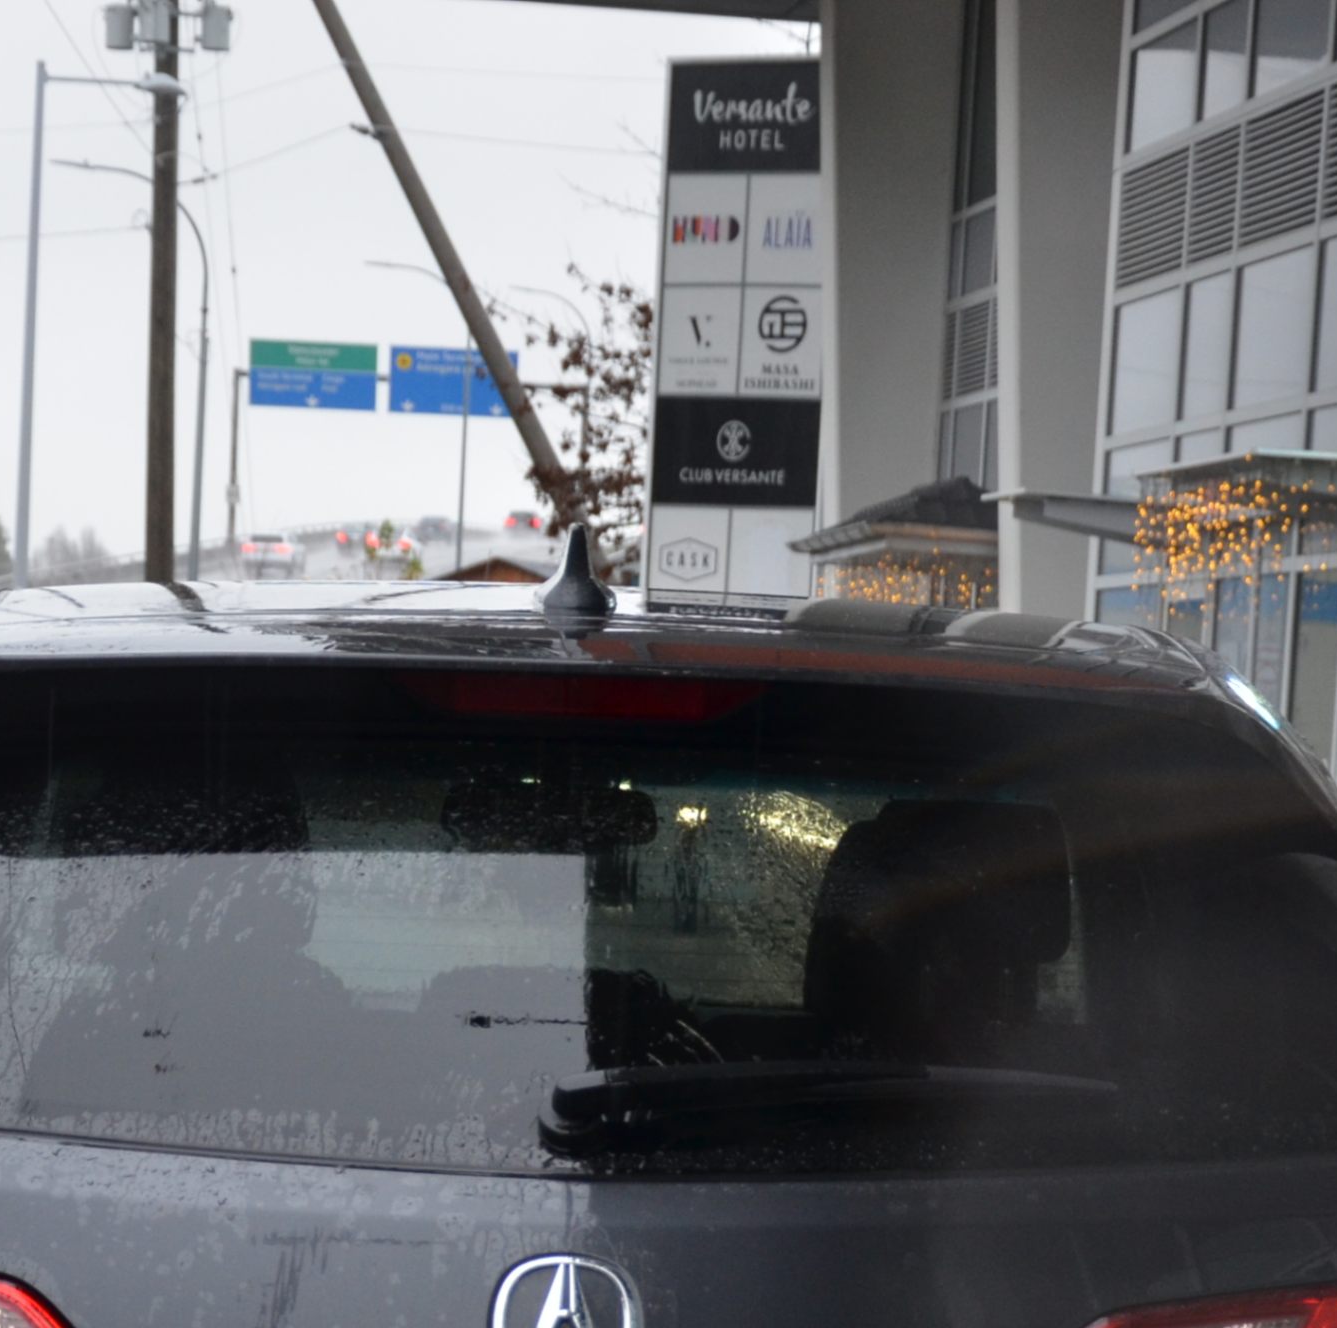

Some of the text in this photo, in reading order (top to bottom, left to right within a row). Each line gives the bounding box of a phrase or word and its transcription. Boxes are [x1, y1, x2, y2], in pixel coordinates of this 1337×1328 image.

[693, 81, 816, 125] Versante
[719, 129, 785, 150] HOTEL
[762, 363, 799, 376] MASA
[744, 377, 815, 391] ISHIBASHI
[679, 467, 713, 483] CLUB
[666, 551, 710, 568] CASK
